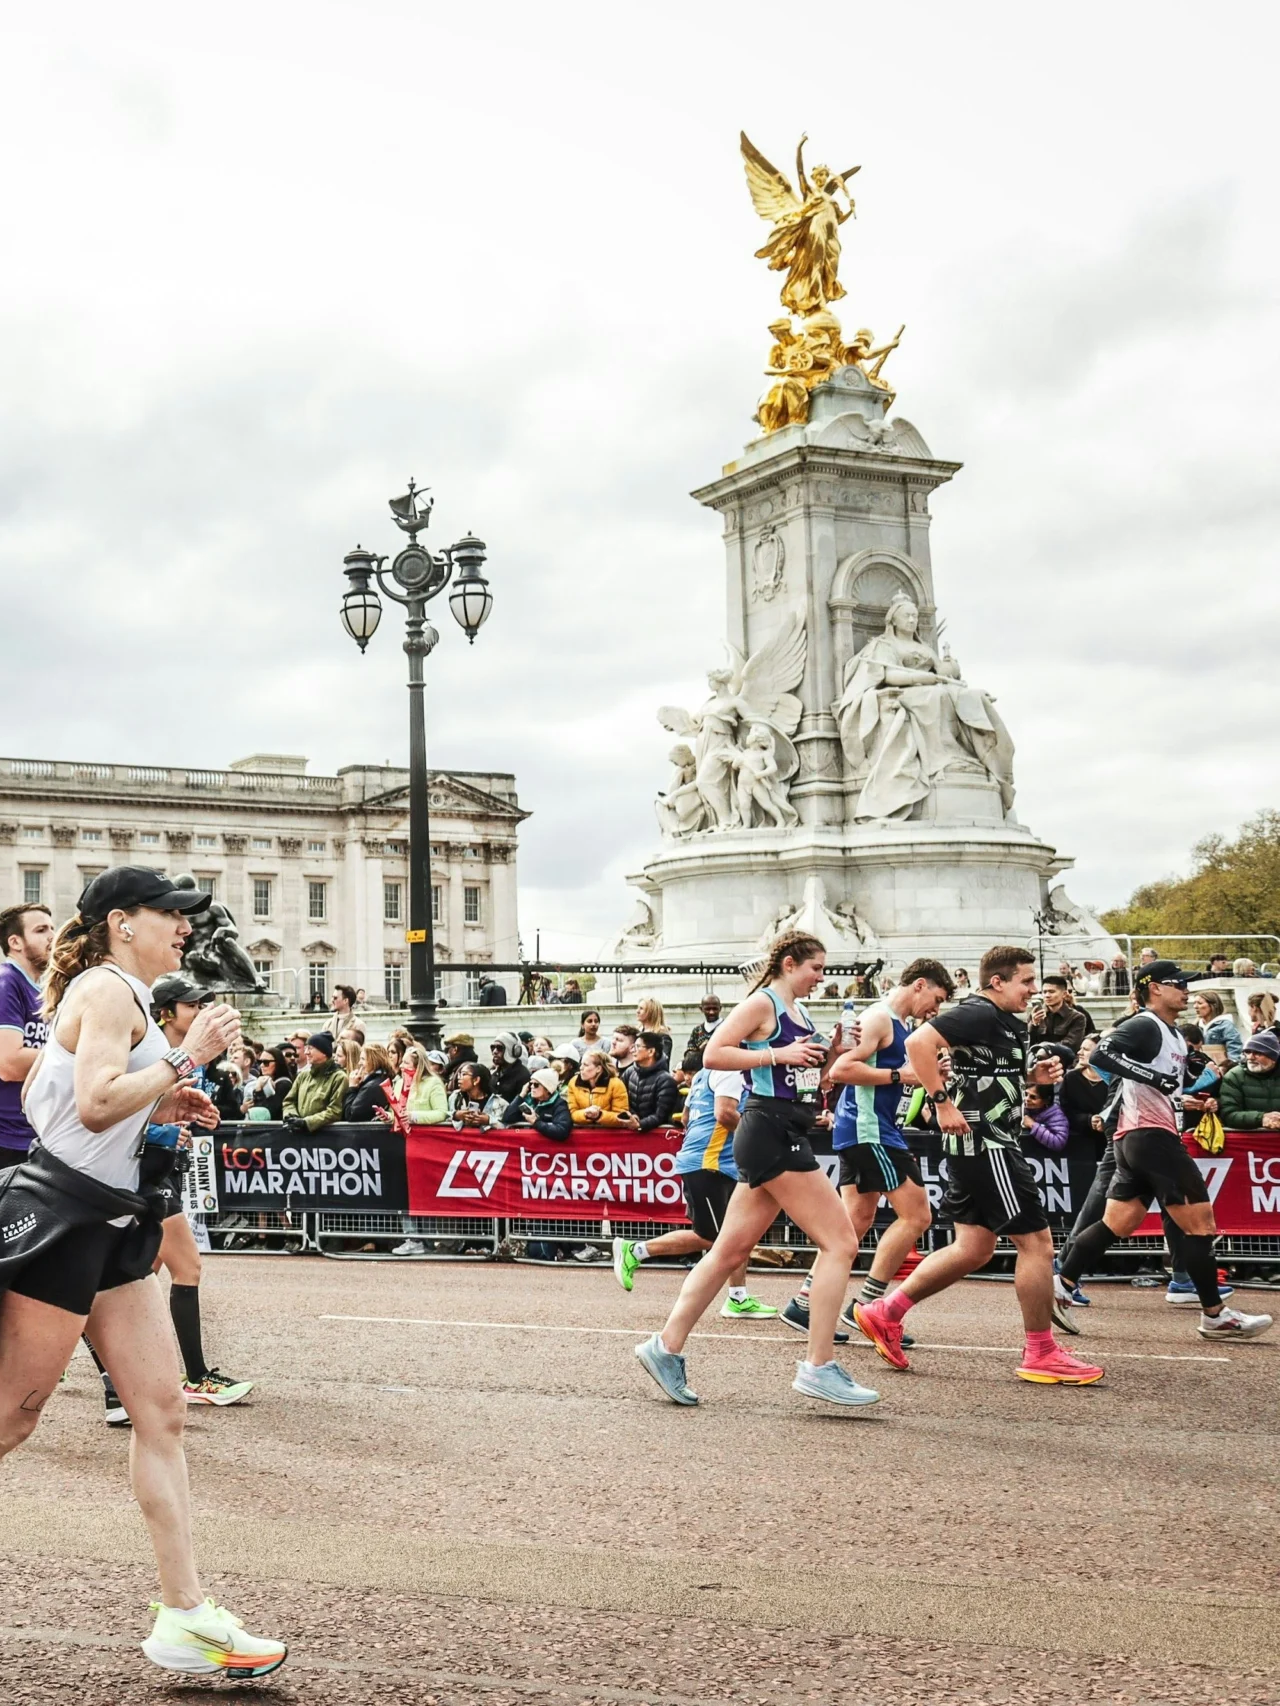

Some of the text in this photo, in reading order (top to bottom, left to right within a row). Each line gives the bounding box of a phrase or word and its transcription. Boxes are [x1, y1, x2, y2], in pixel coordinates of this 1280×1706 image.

[197, 1156, 210, 1192] DANNY
[570, 1152, 677, 1178] LONDO
[224, 1171, 382, 1196] MARATHON
[521, 1176, 688, 1205] MARATHO
[190, 1200, 198, 1210] US
[1, 1213, 36, 1232] WOMEN
[3, 1218, 37, 1239] LEADERS
